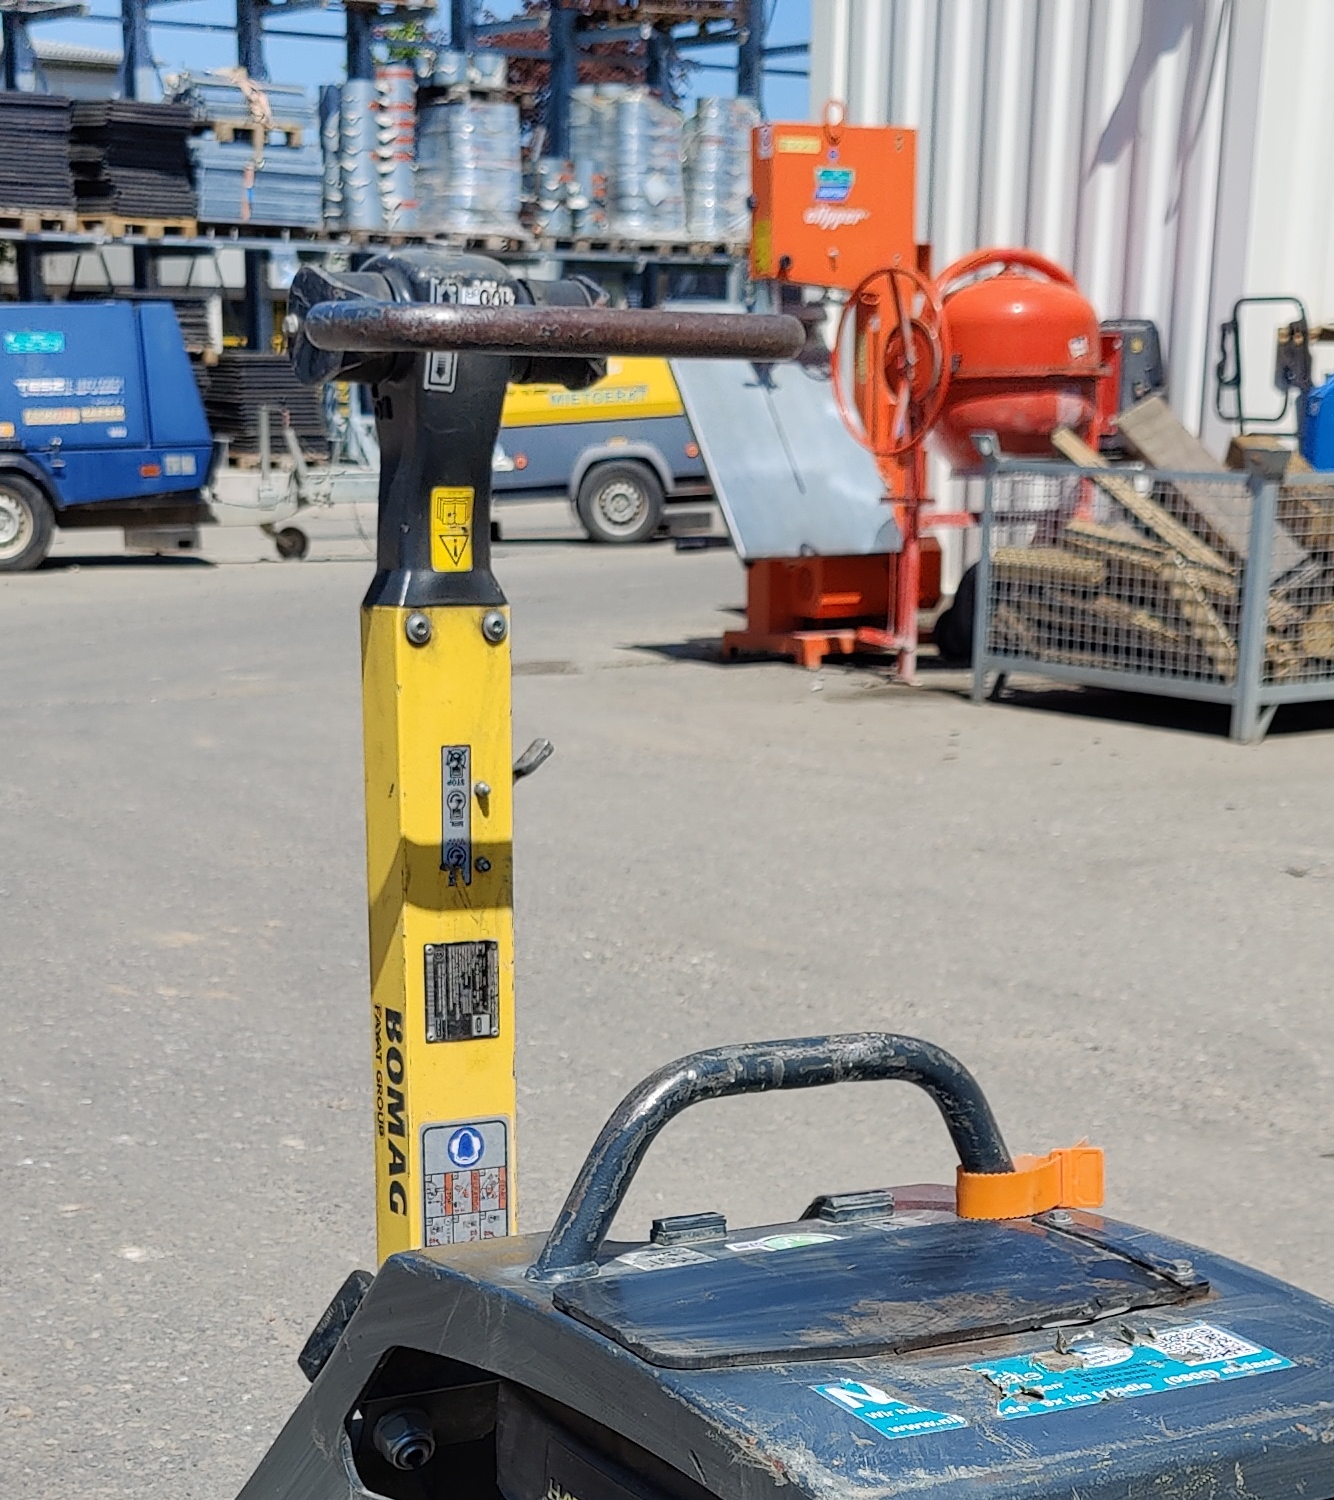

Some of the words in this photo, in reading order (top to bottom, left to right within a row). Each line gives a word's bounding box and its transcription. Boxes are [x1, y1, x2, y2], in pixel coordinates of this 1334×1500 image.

[374, 1003, 383, 1064] FAYAT
[376, 1069, 385, 1140] GROUP
[385, 1007, 408, 1217] BOMAG
